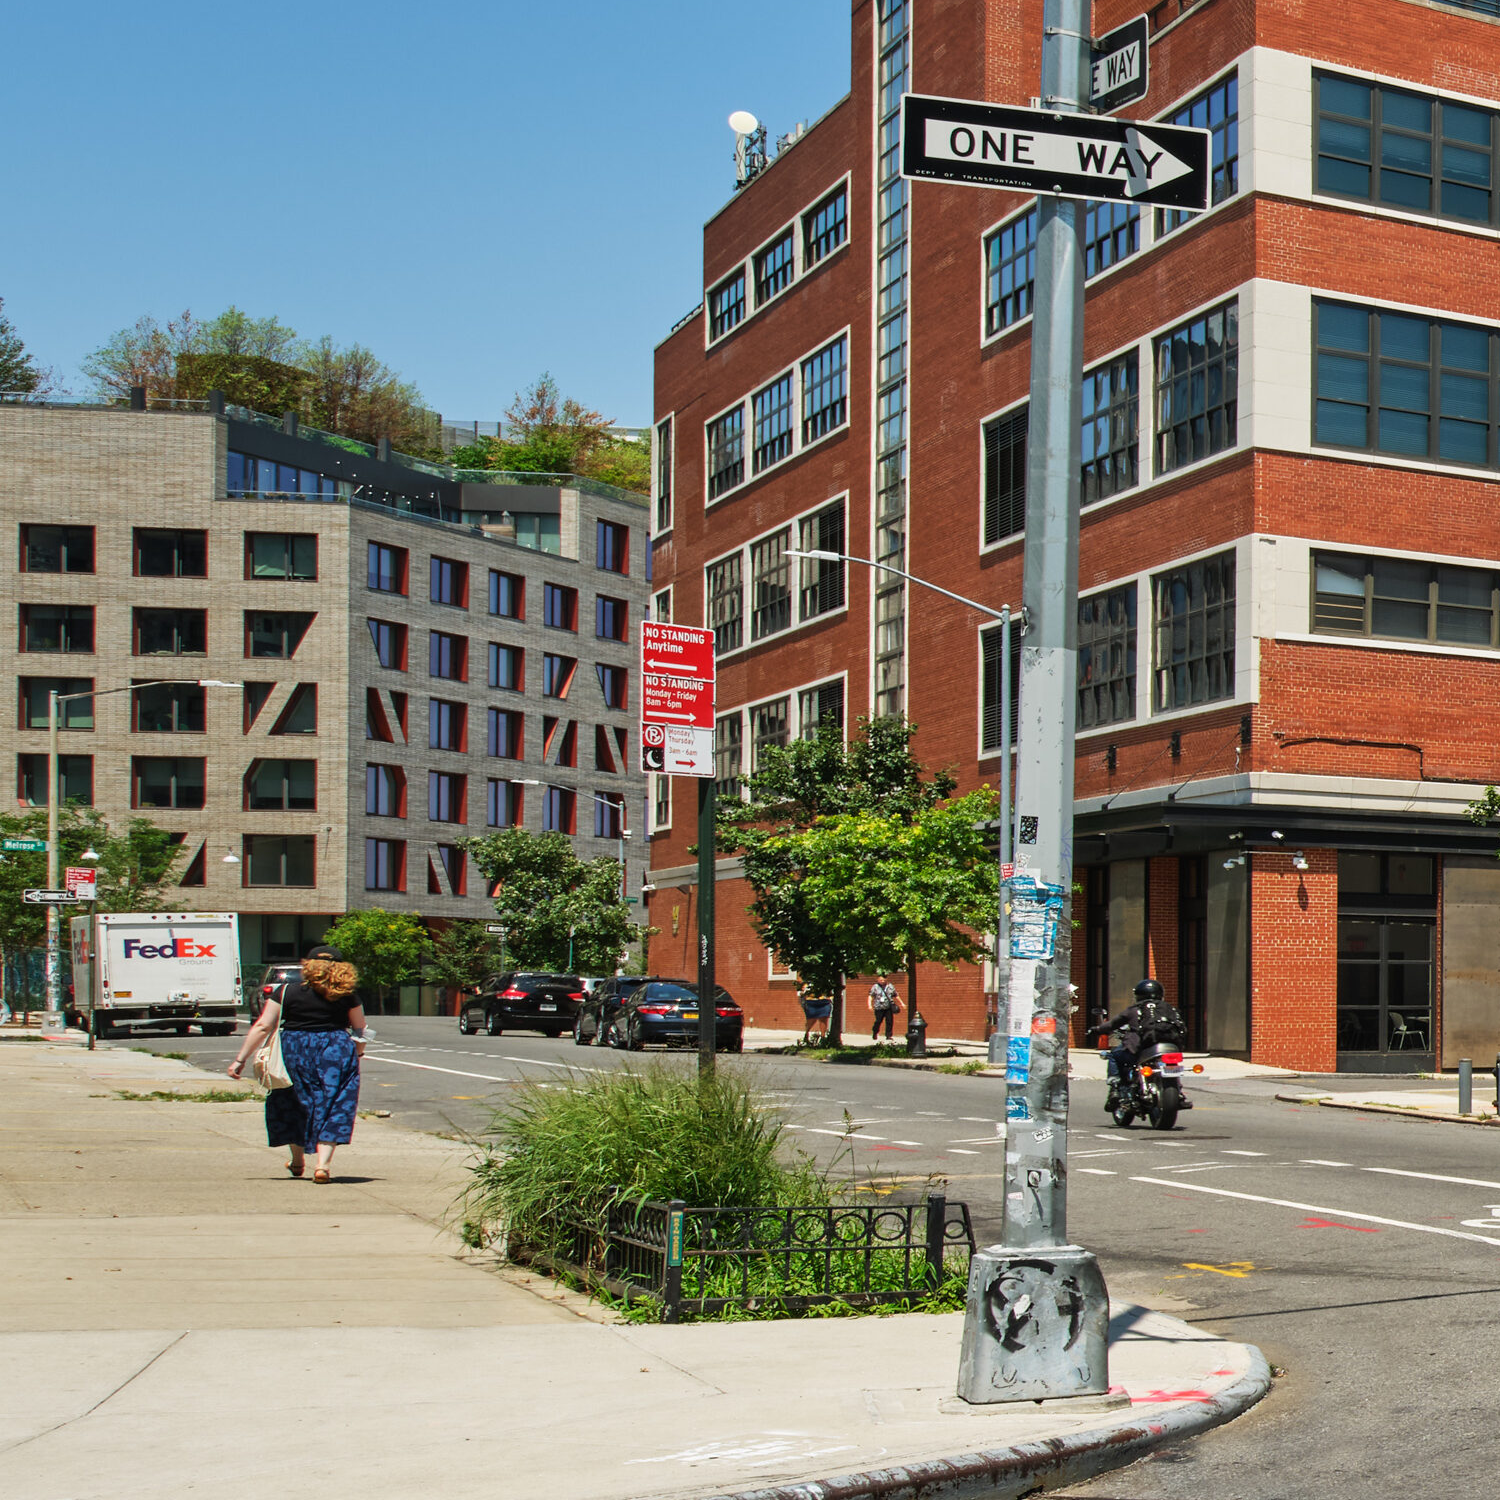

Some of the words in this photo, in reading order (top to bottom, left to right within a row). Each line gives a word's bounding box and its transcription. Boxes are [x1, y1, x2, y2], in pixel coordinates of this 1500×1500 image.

[1107, 46, 1136, 88] WAY
[950, 127, 1035, 165] ONE
[1077, 142, 1163, 179] WAY
[962, 174, 1032, 186] TRANSPORTATION
[646, 627, 659, 638] NO
[661, 629, 705, 644] STANDING
[646, 640, 684, 654] Anytime
[646, 676, 658, 686] NO
[661, 677, 704, 691] STANDING
[646, 688, 671, 699] Monday
[676, 691, 697, 702] Friday
[646, 697, 661, 706] 8am
[667, 700, 682, 709] 6pm
[668, 728, 690, 737] Monday
[668, 736, 694, 746] Thursday
[5, 841, 35, 849] Melrose
[124, 938, 217, 959] FedEx
